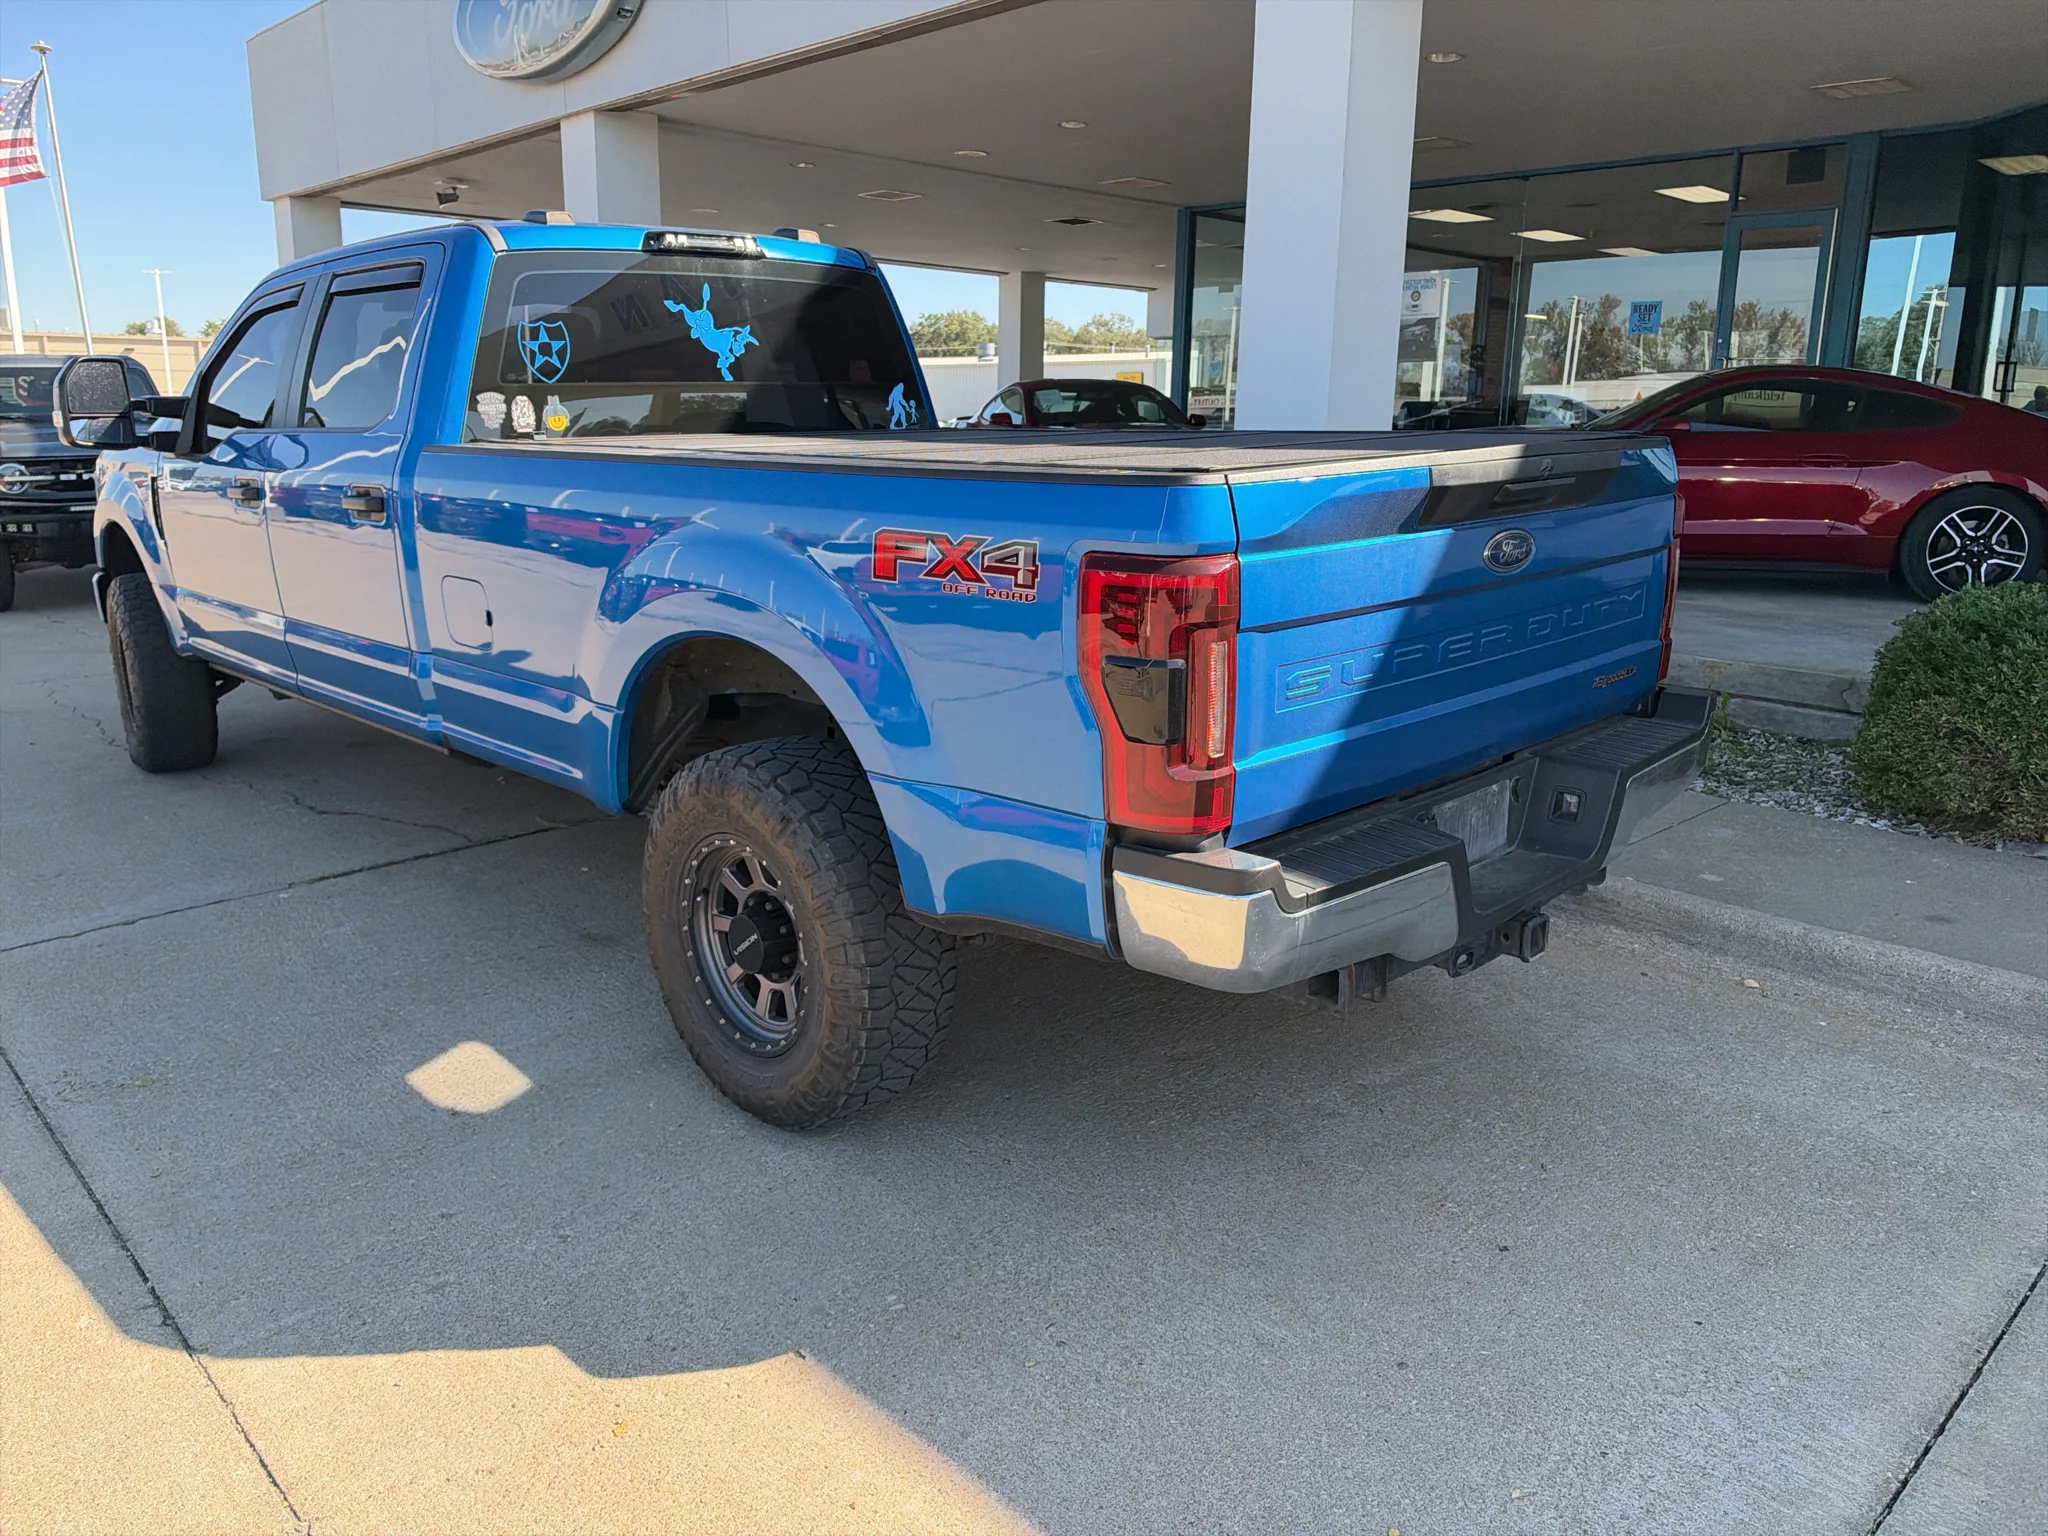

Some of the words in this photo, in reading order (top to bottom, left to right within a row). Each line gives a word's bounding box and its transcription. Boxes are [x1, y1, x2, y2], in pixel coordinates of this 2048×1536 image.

[1632, 303, 1659, 313] READY
[1637, 313, 1652, 322] SET
[1631, 321, 1655, 333] Ford
[872, 526, 1041, 592] FX4
[1499, 539, 1528, 563] Ford
[942, 582, 979, 597] OFF
[985, 587, 1037, 603] ROAD
[1285, 624, 1513, 701] SUPER
[1526, 589, 1642, 640] DUTY
[733, 932, 759, 956] VISION
